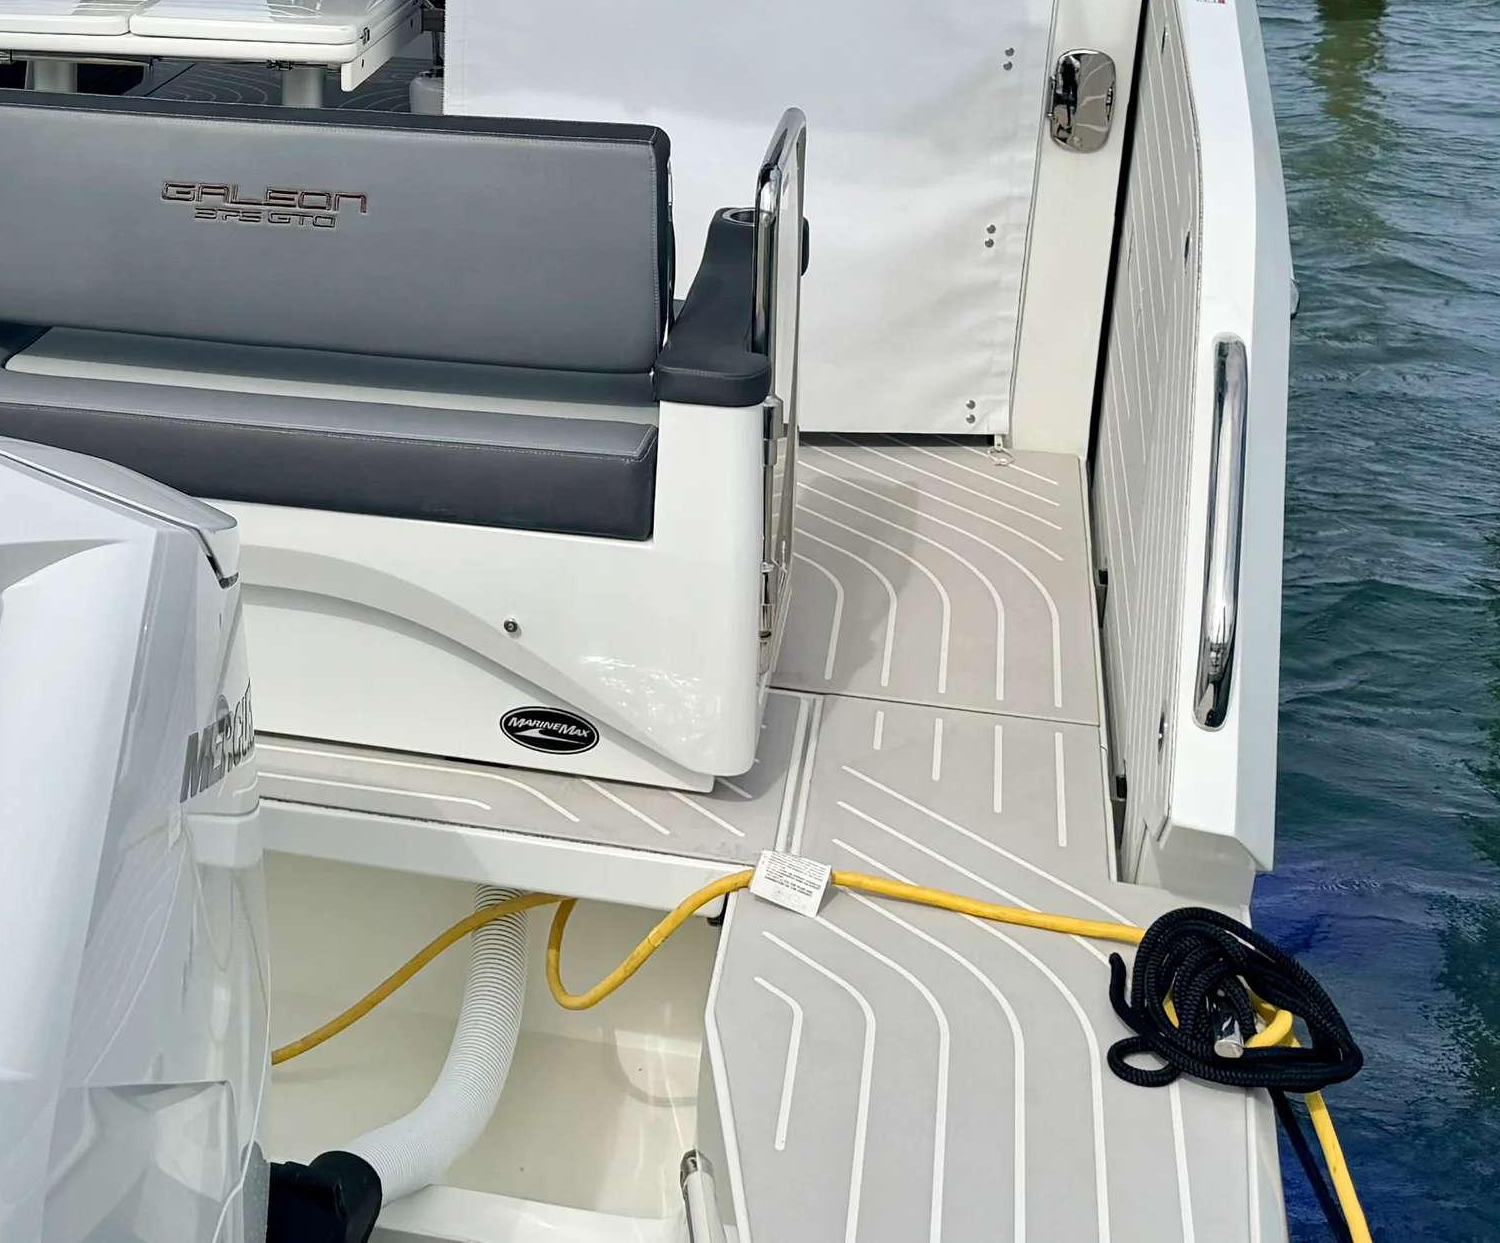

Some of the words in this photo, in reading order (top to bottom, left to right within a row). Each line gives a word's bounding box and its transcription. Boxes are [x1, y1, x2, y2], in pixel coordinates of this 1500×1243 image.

[161, 181, 368, 214] GALEON
[194, 207, 263, 223] 375
[268, 212, 336, 229] GTO
